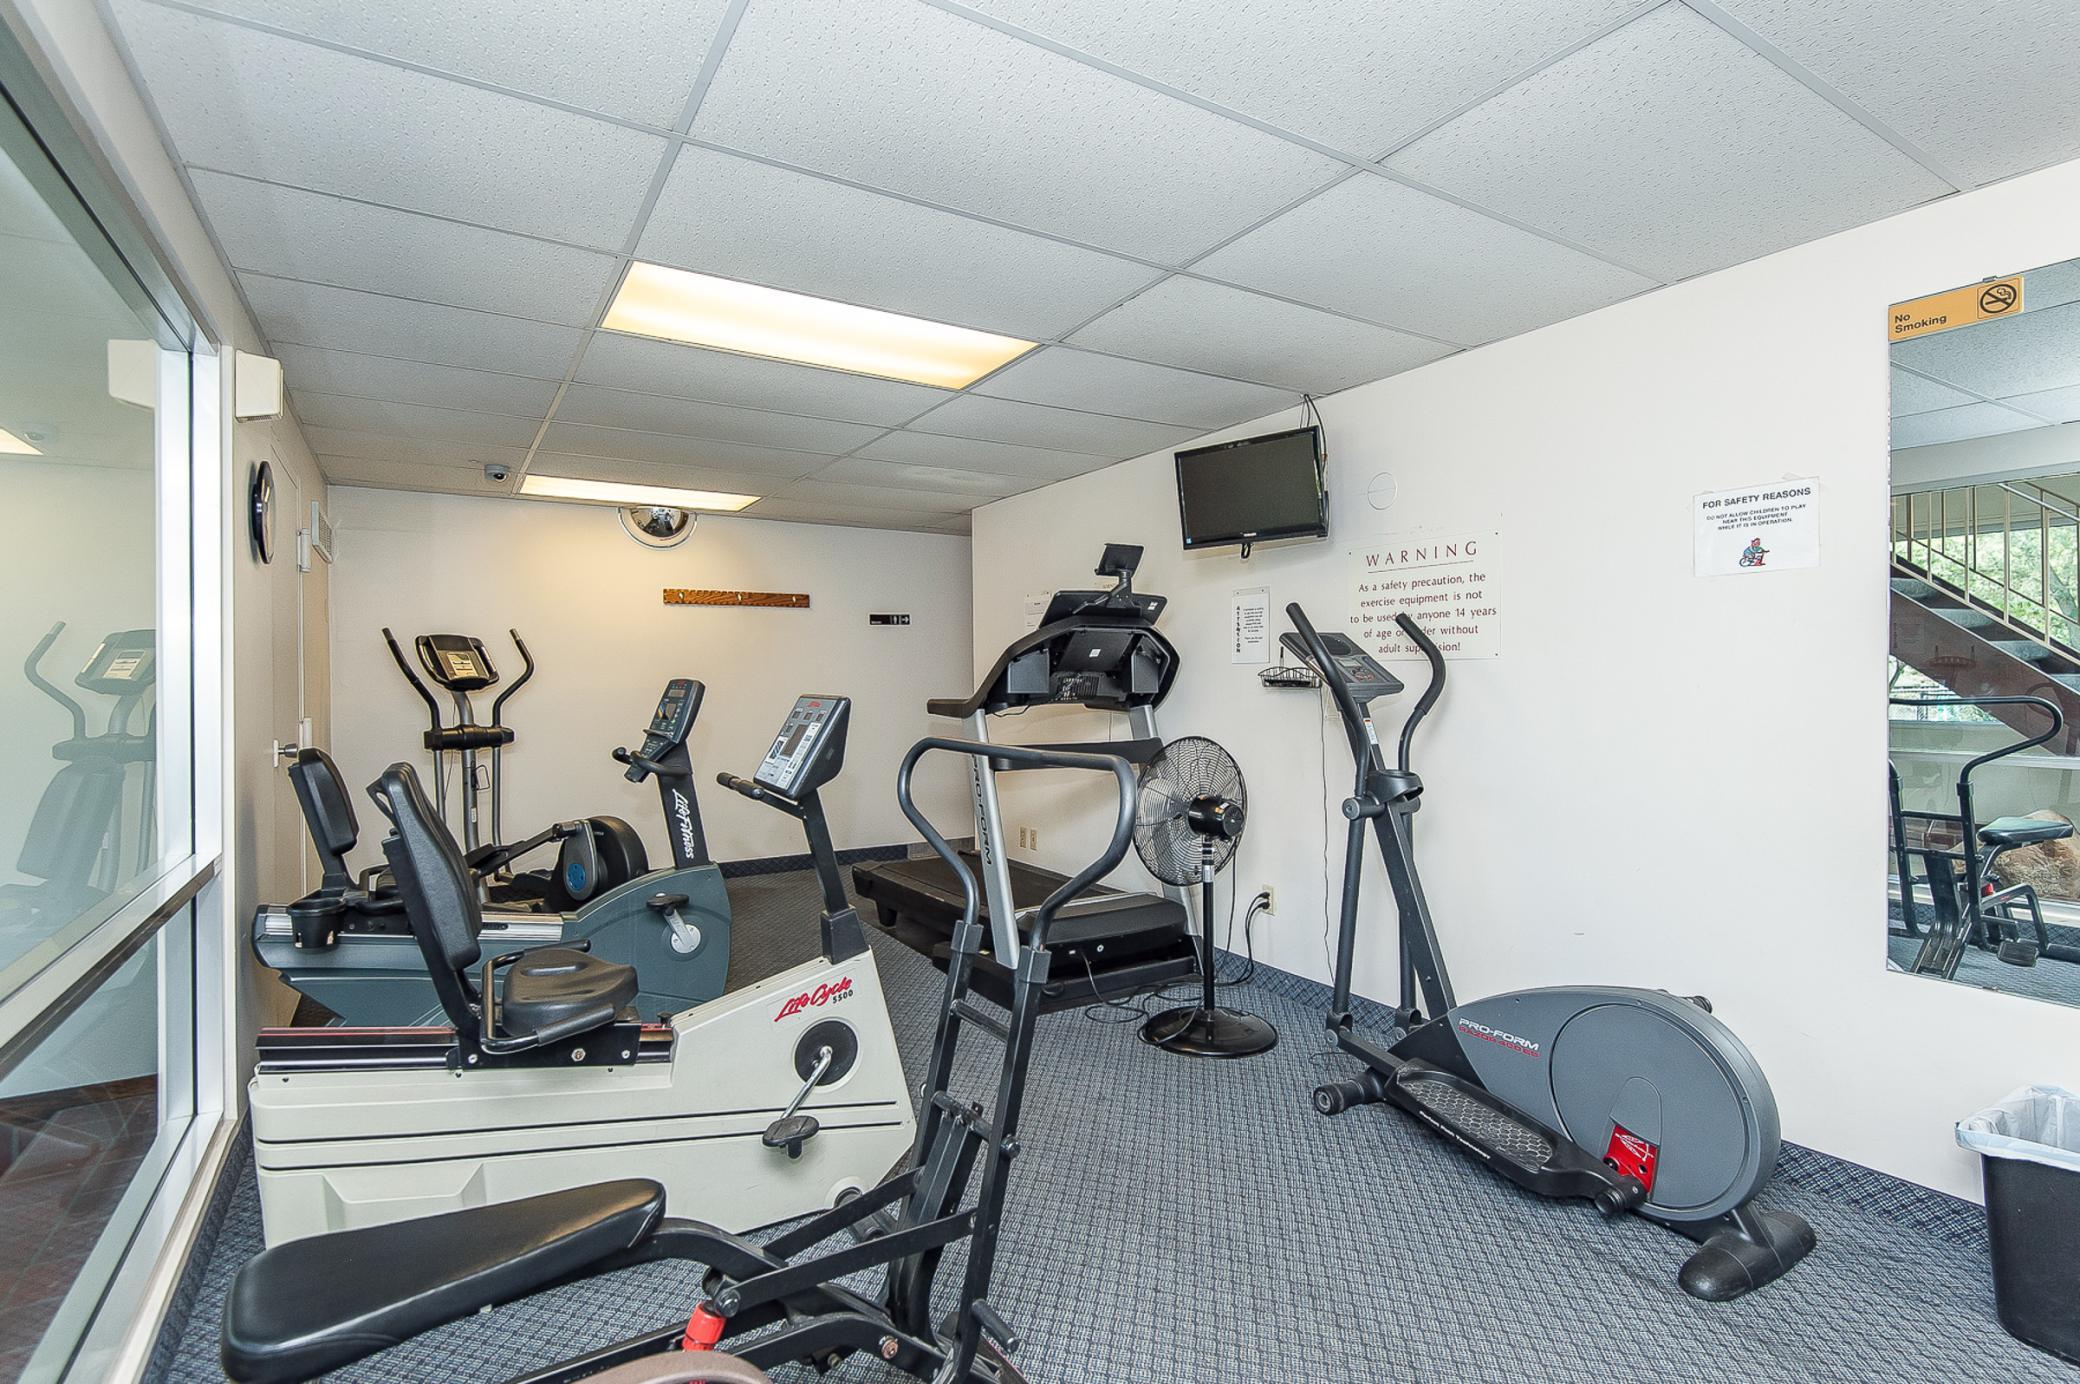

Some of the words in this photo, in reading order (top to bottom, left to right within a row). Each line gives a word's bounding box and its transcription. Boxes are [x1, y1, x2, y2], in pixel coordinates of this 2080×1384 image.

[1894, 313, 1911, 324] No
[1895, 315, 1947, 333] Smoking
[1702, 500, 1722, 509] FOR
[1724, 494, 1760, 506] SAFETY
[1762, 487, 1812, 501] REASONS
[1716, 512, 1729, 520] NOT
[1749, 507, 1780, 515] CHILDREN
[1753, 511, 1789, 521] EQUIPMENT
[1366, 540, 1477, 567] WARNING
[1358, 583, 1369, 593] As
[1372, 583, 1377, 591] a
[1381, 579, 1408, 591] safety
[1411, 573, 1465, 590] precaution,
[1469, 572, 1486, 583] the
[1360, 597, 1396, 608] exercise
[1399, 593, 1448, 607] equipment
[1453, 591, 1462, 601] is
[1465, 589, 1483, 599] not
[1363, 612, 1374, 623] be
[1376, 611, 1397, 622] used
[1417, 610, 1451, 621] anyone
[1455, 607, 1466, 618] 14
[1470, 606, 1497, 618] years
[1363, 629, 1372, 639] of
[1376, 630, 1392, 641] age
[1440, 624, 1479, 635] without
[1378, 643, 1401, 654] adult
[971, 753, 993, 865] PRO-FORM
[832, 989, 854, 1004] 5500
[1459, 1017, 1540, 1051] PRO-FORM
